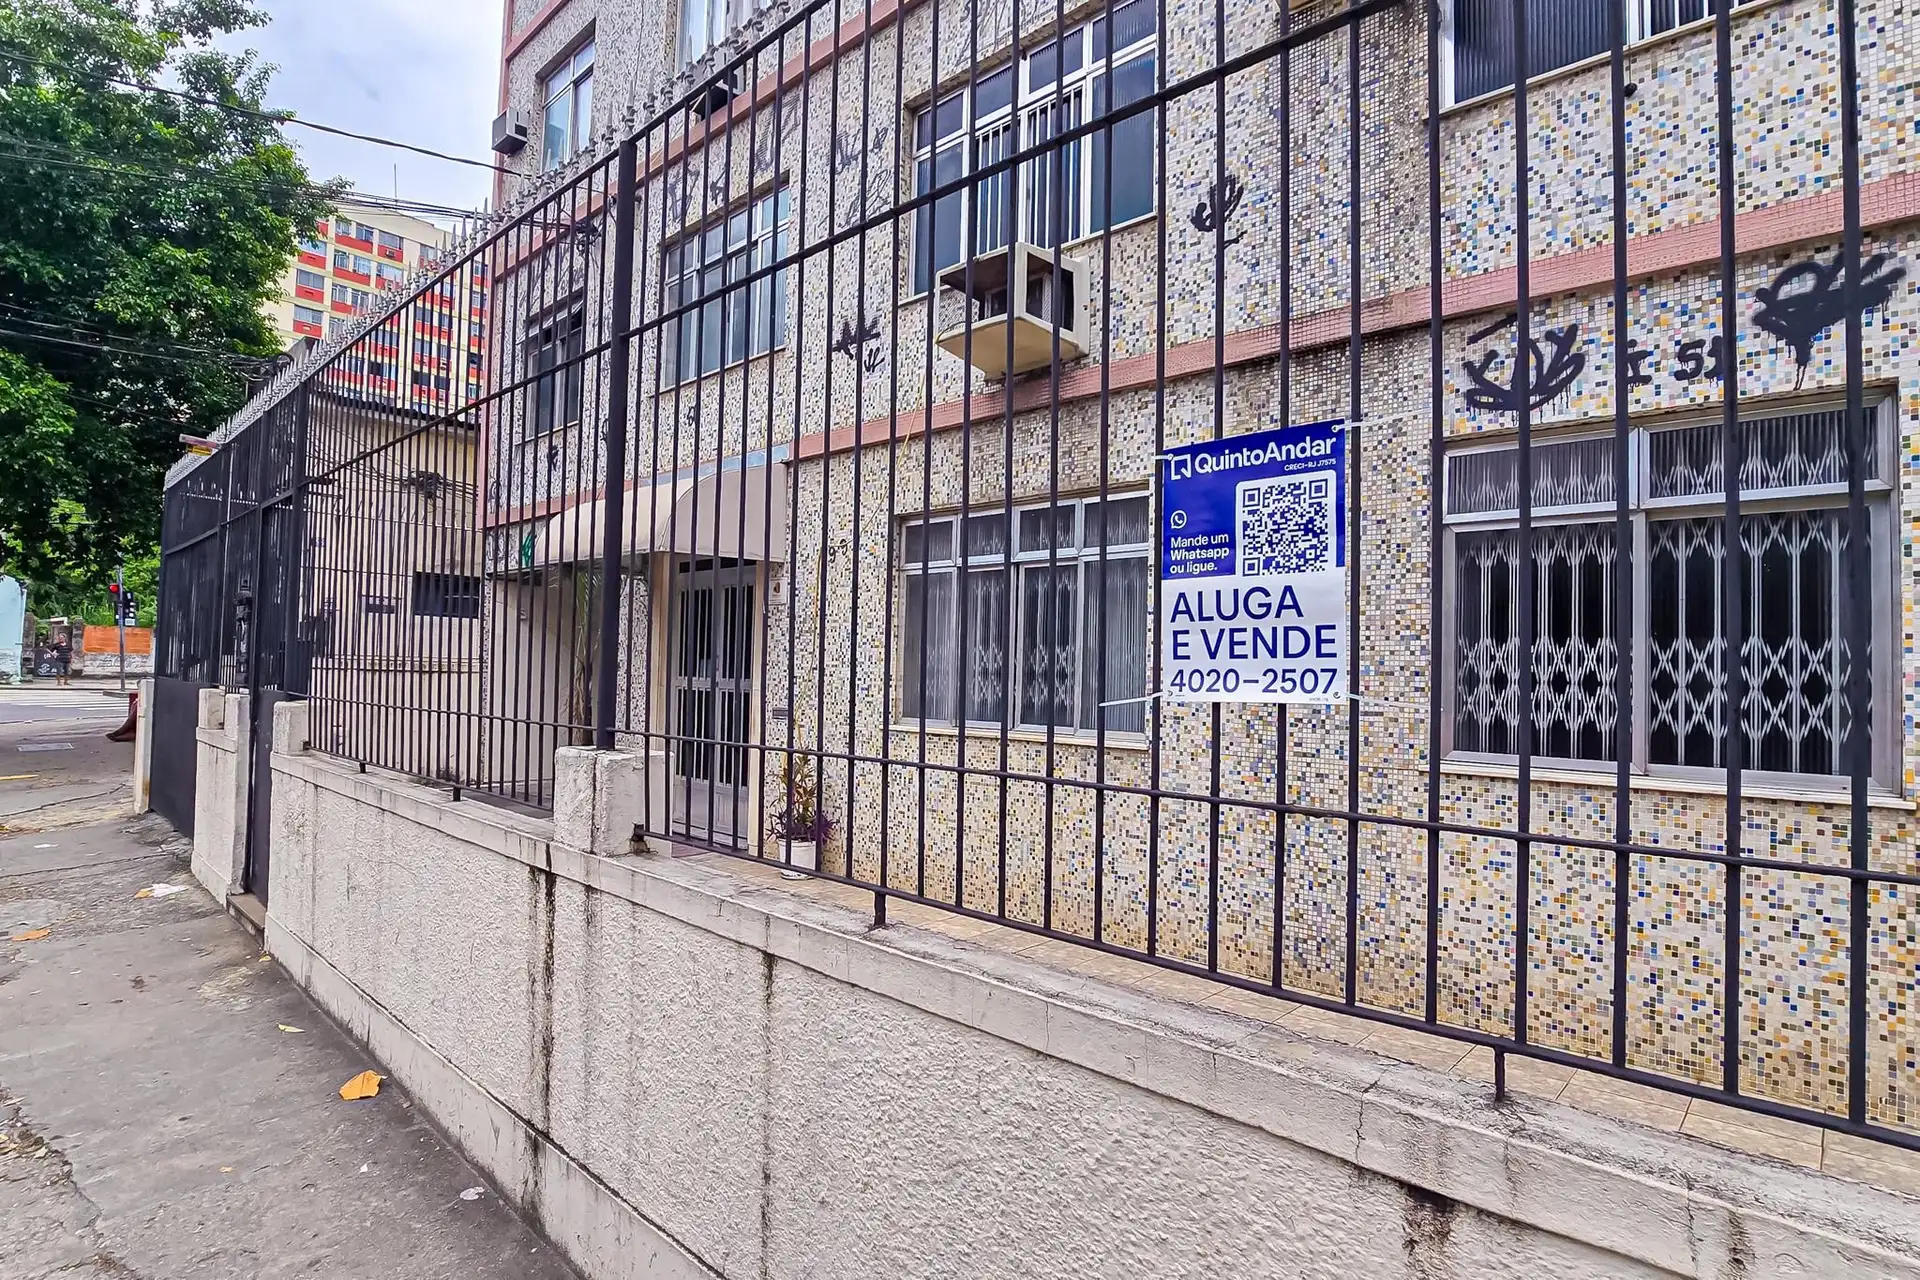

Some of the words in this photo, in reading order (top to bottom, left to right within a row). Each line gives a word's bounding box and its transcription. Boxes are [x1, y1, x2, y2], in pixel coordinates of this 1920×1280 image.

[1194, 435, 1337, 475] QuintoAndar
[1284, 461, 1316, 472] CRECI-RJ
[1170, 534, 1209, 549] Mande
[1210, 532, 1229, 545] um
[1170, 545, 1230, 562] Whatsapp
[1169, 562, 1185, 574] ou
[1186, 560, 1218, 575] ligue.
[1170, 584, 1304, 624] ALUGA
[1172, 628, 1191, 661] E
[1200, 624, 1338, 661] VENDE
[1169, 667, 1338, 695] 4020-2507
